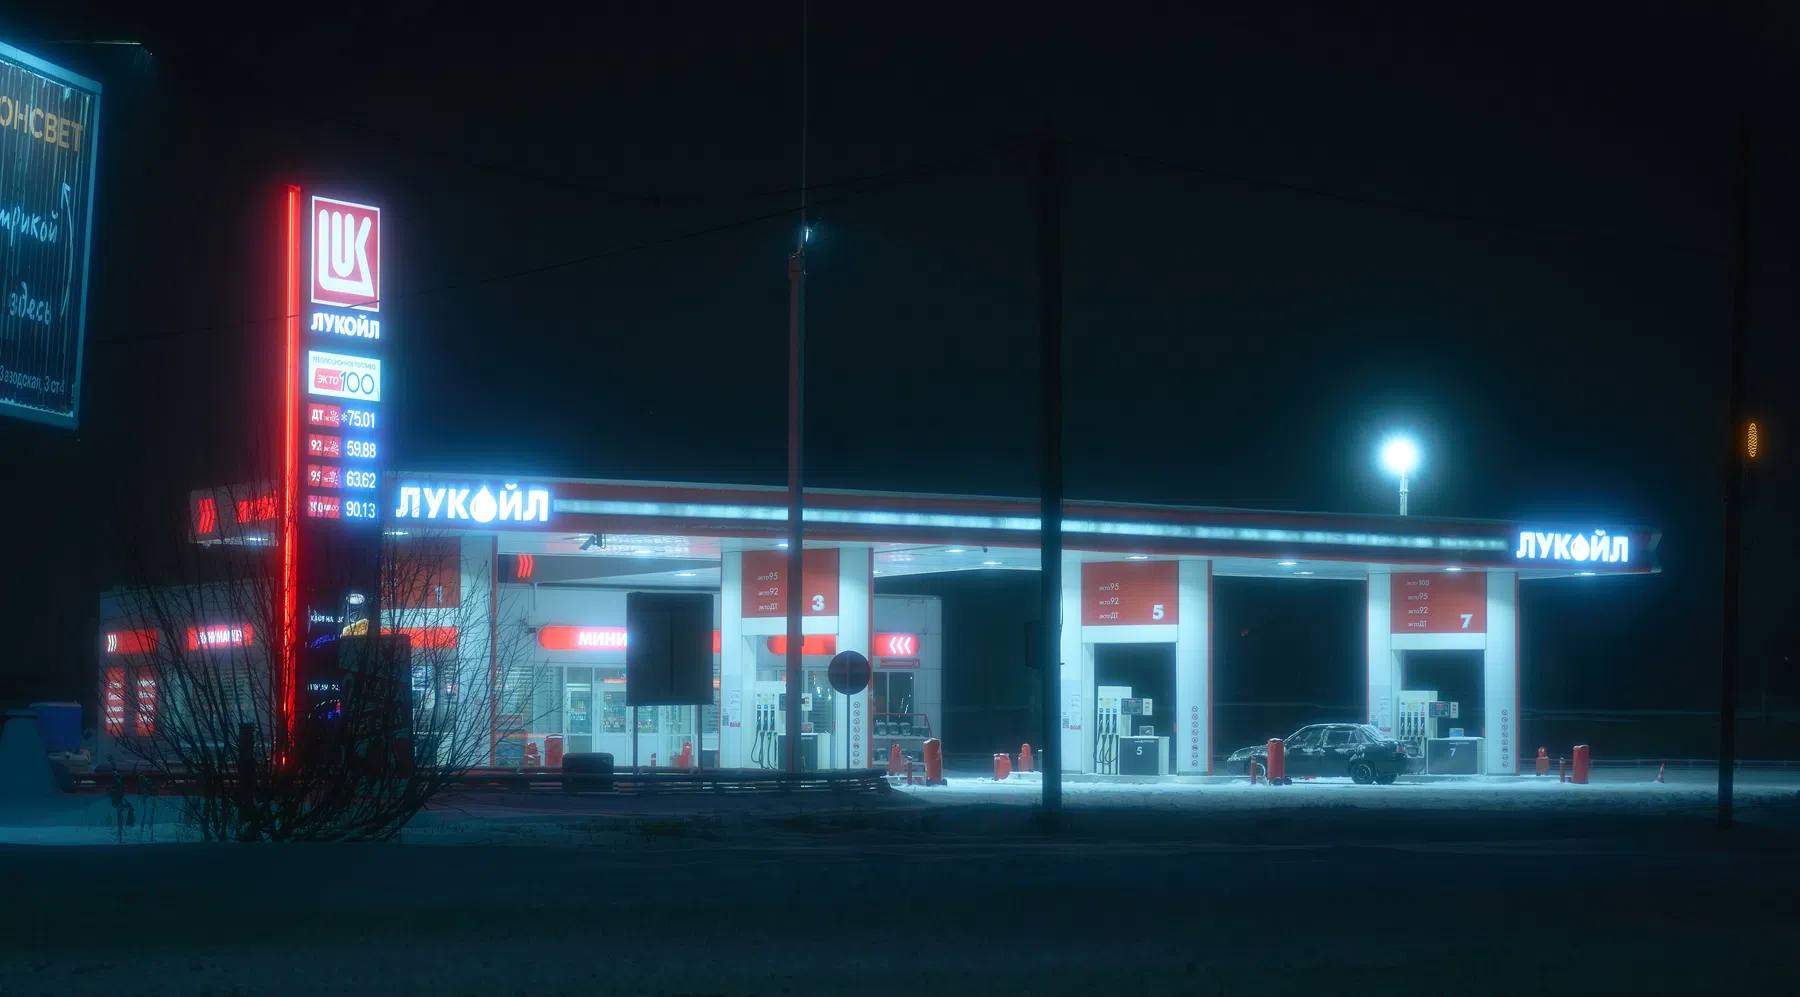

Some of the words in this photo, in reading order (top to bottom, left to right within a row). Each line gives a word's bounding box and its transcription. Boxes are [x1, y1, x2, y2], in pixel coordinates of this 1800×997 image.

[9, 281, 52, 326] здесь
[311, 312, 380, 339] ЛУКОЙЛ
[311, 408, 323, 422] ДТ
[311, 439, 322, 451] 92
[346, 440, 376, 459] 59.88
[346, 470, 376, 489] 63.62
[346, 501, 376, 519] 90.13
[395, 483, 549, 523] ЛУКОЙЛ
[1515, 529, 1629, 563] ЛУКОЙЛ
[811, 594, 825, 612] 3
[1152, 604, 1165, 620] 5
[1460, 613, 1474, 629] 7
[1136, 746, 1143, 756] 5
[1449, 747, 1457, 757] 7
